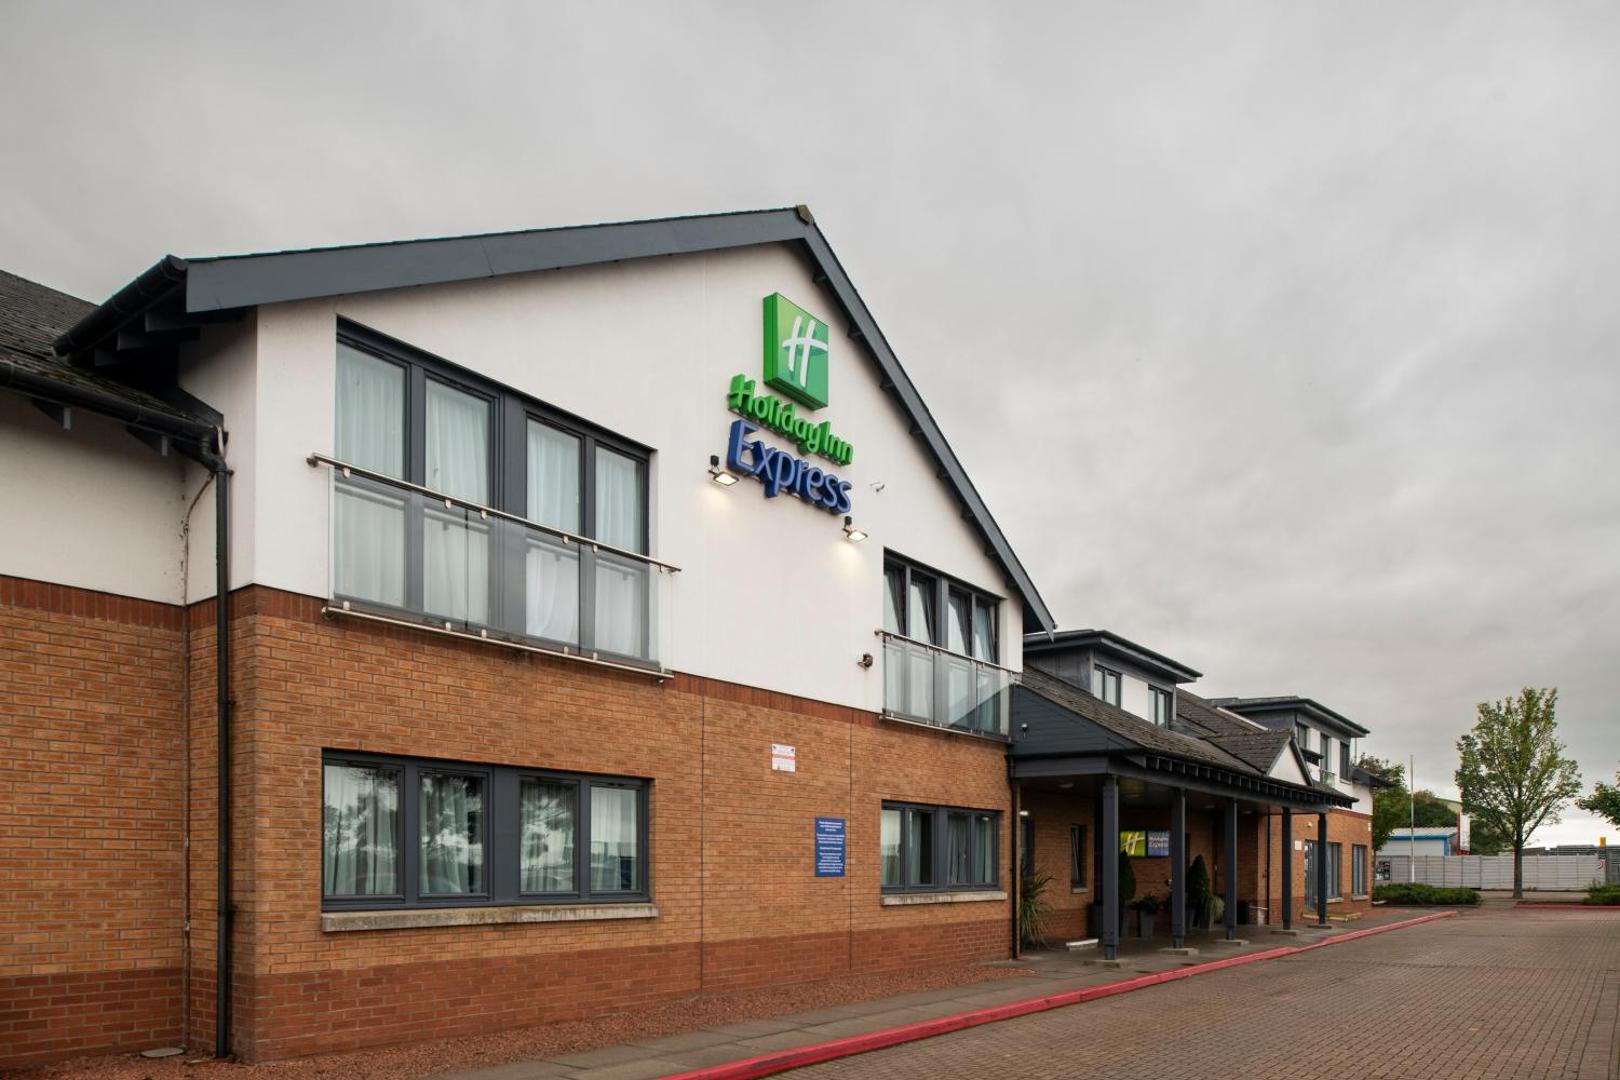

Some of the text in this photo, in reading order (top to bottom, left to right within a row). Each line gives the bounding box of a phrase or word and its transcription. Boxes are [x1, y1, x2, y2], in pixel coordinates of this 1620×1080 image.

[729, 374, 853, 465] Holiday Inn
[728, 419, 852, 514] Express
